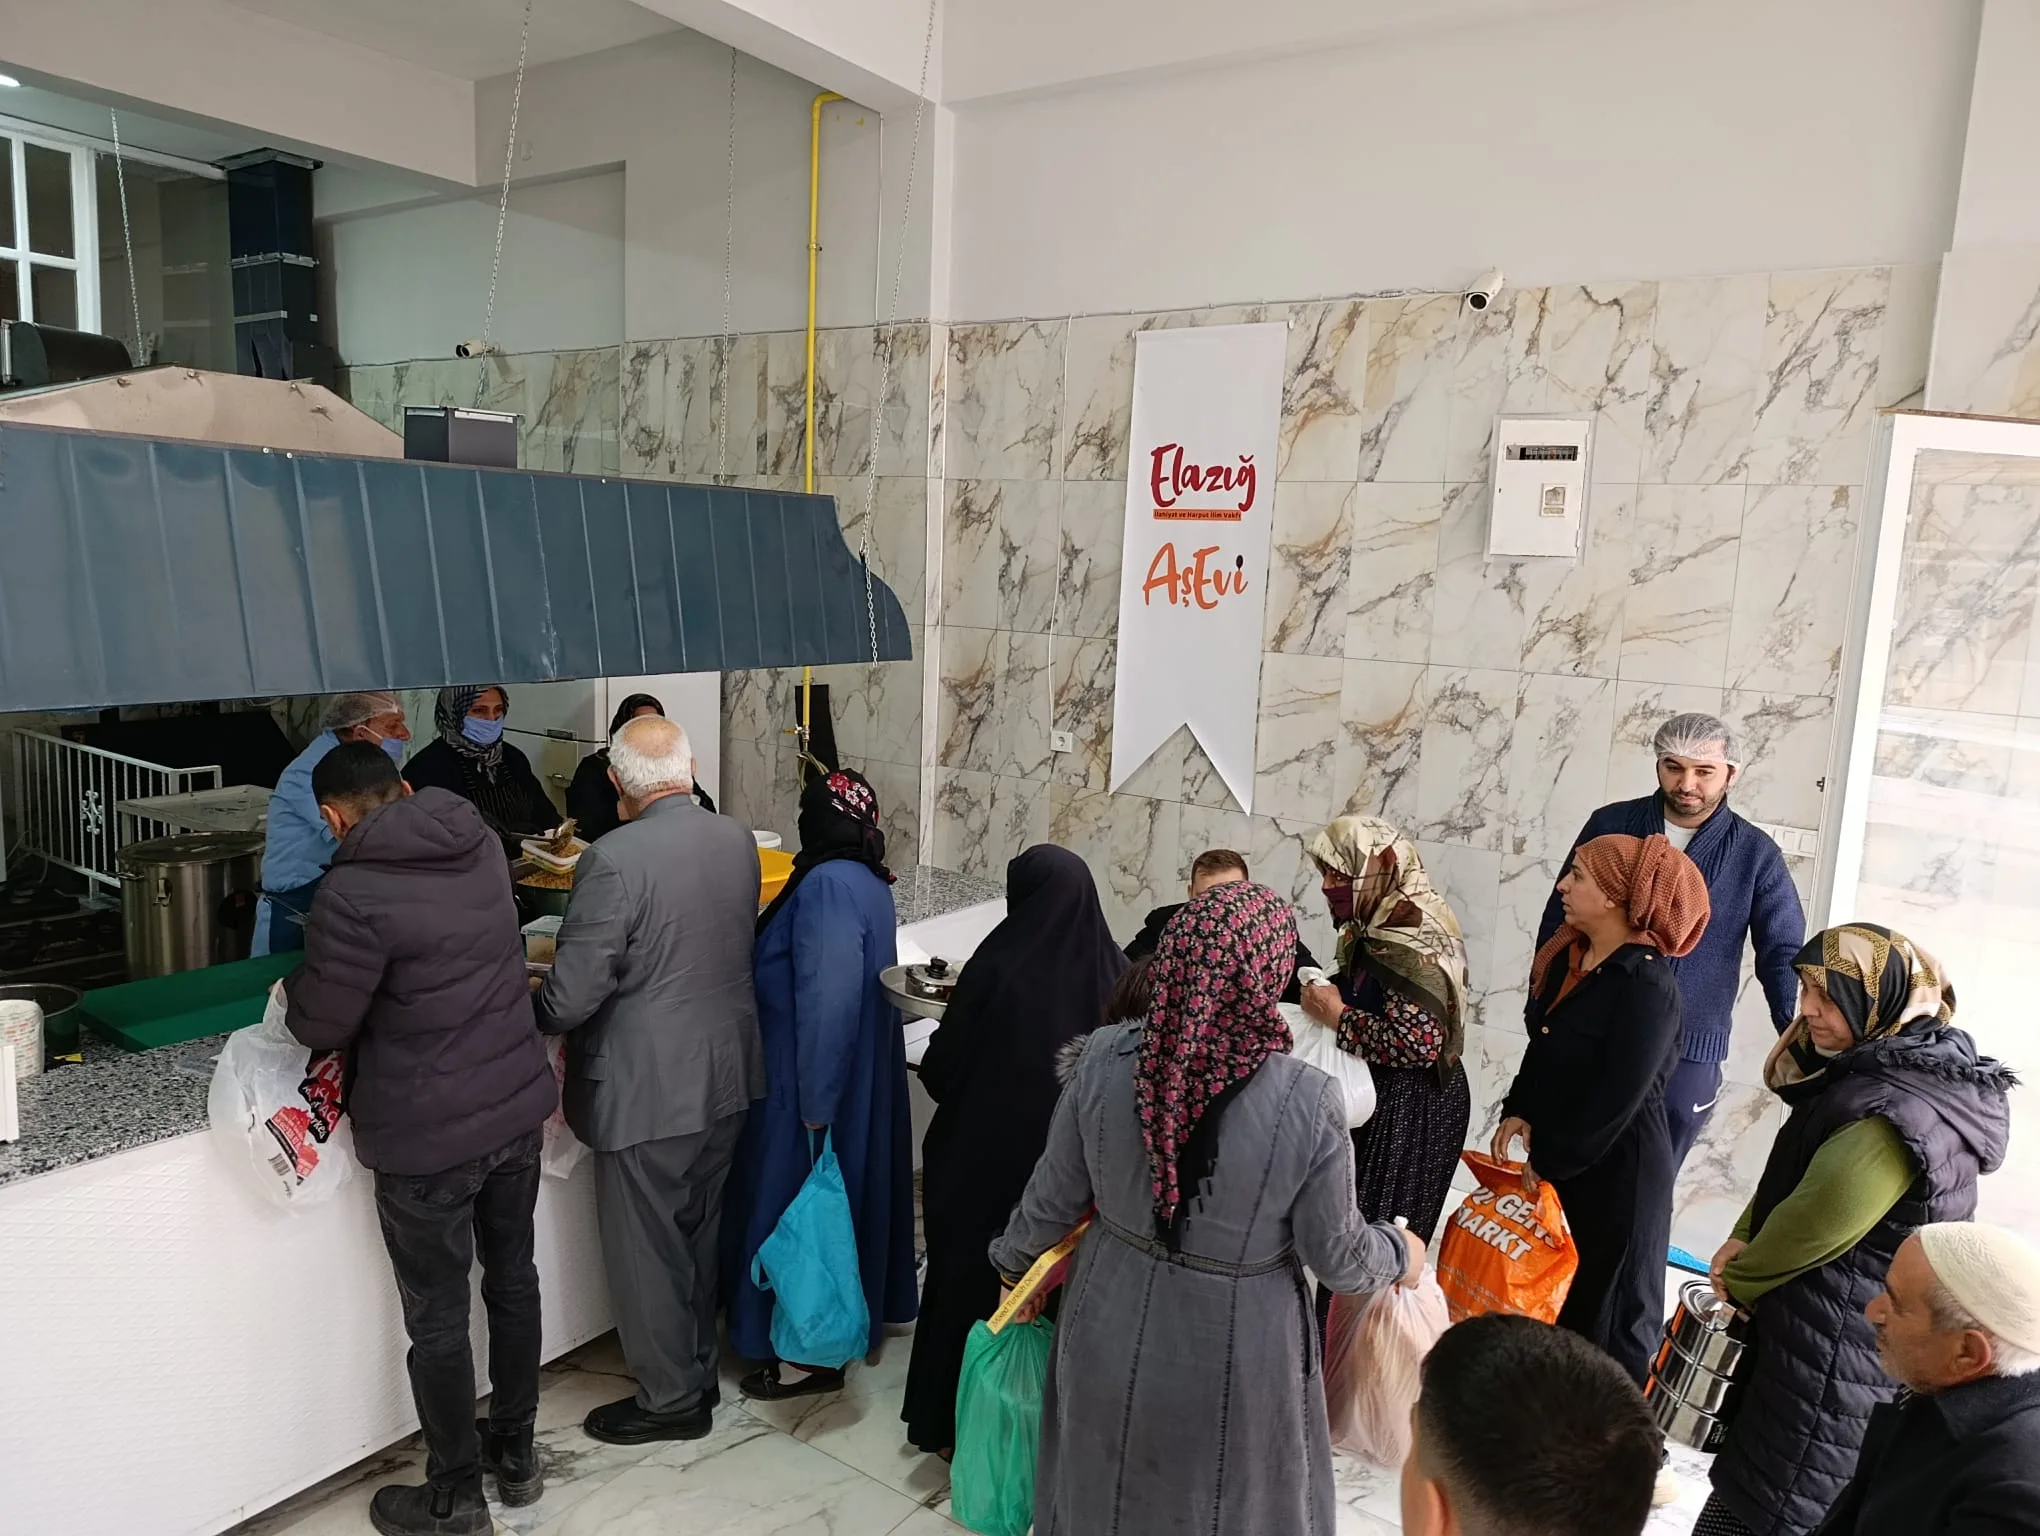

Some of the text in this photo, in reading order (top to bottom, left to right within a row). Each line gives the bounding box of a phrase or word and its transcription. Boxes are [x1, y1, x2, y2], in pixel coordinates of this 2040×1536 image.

[1150, 443, 1256, 512] Elazığ
[1188, 511, 1209, 519] Harput
[1223, 511, 1241, 519] Vakfı
[1142, 542, 1249, 610] AşEvi
